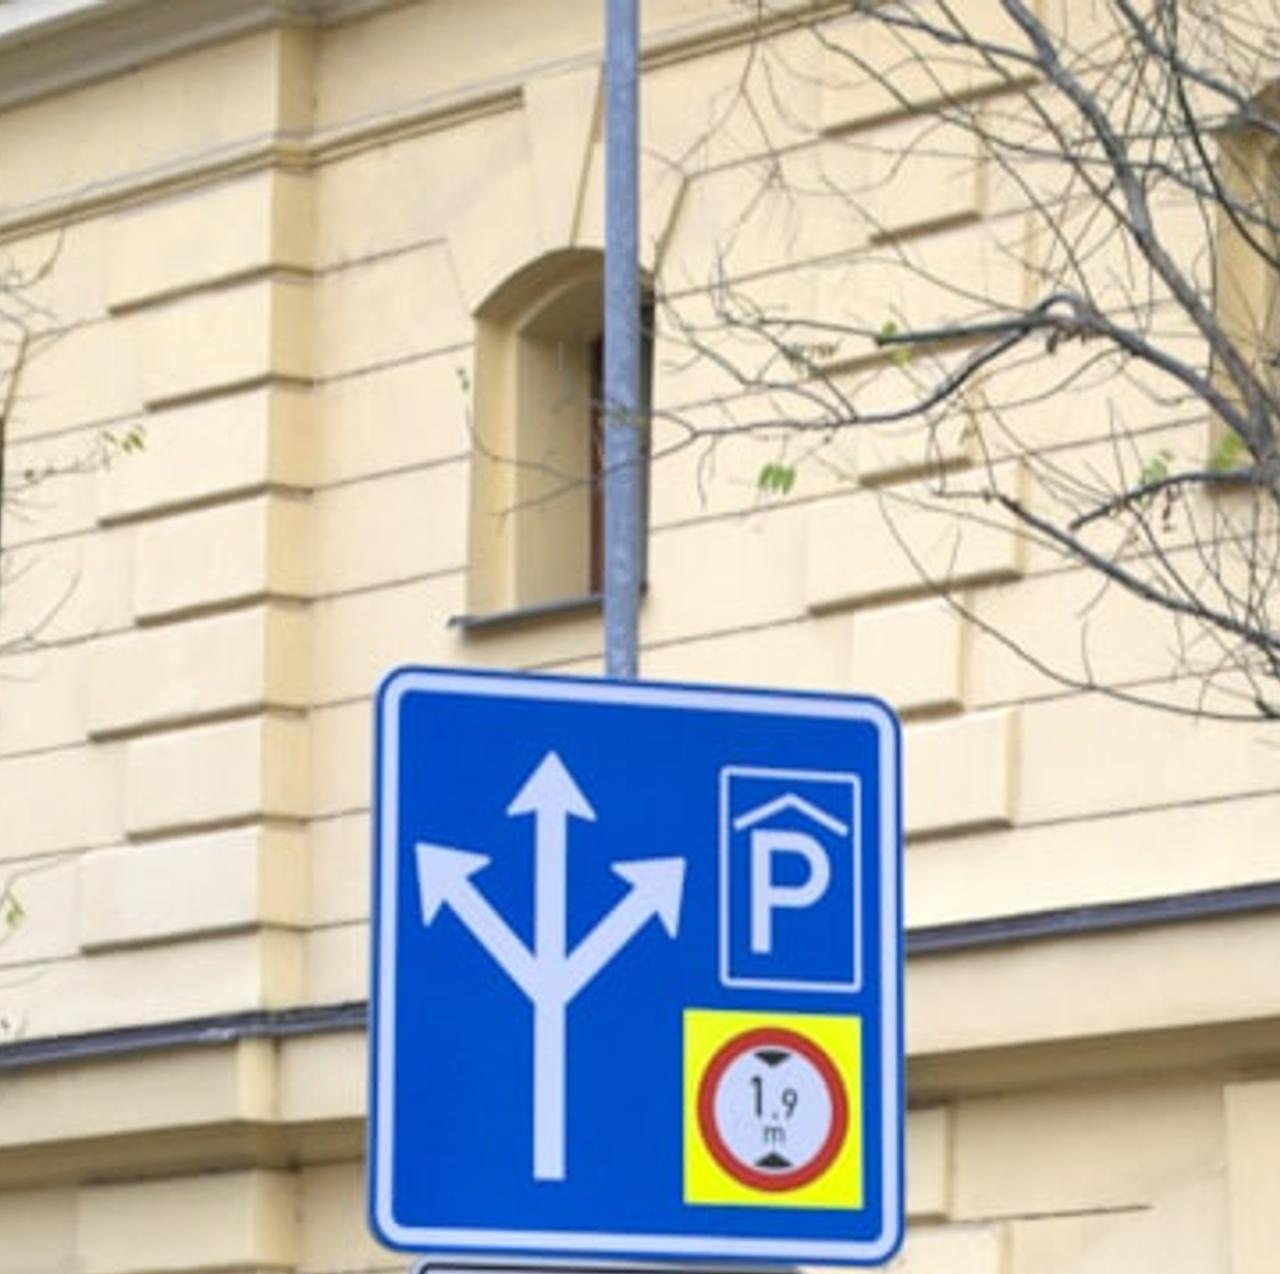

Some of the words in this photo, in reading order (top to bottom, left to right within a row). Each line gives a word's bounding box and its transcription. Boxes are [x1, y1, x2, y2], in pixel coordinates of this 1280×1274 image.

[751, 829, 830, 953] P
[751, 1076, 798, 1119] 1.9
[764, 1126, 785, 1144] m
